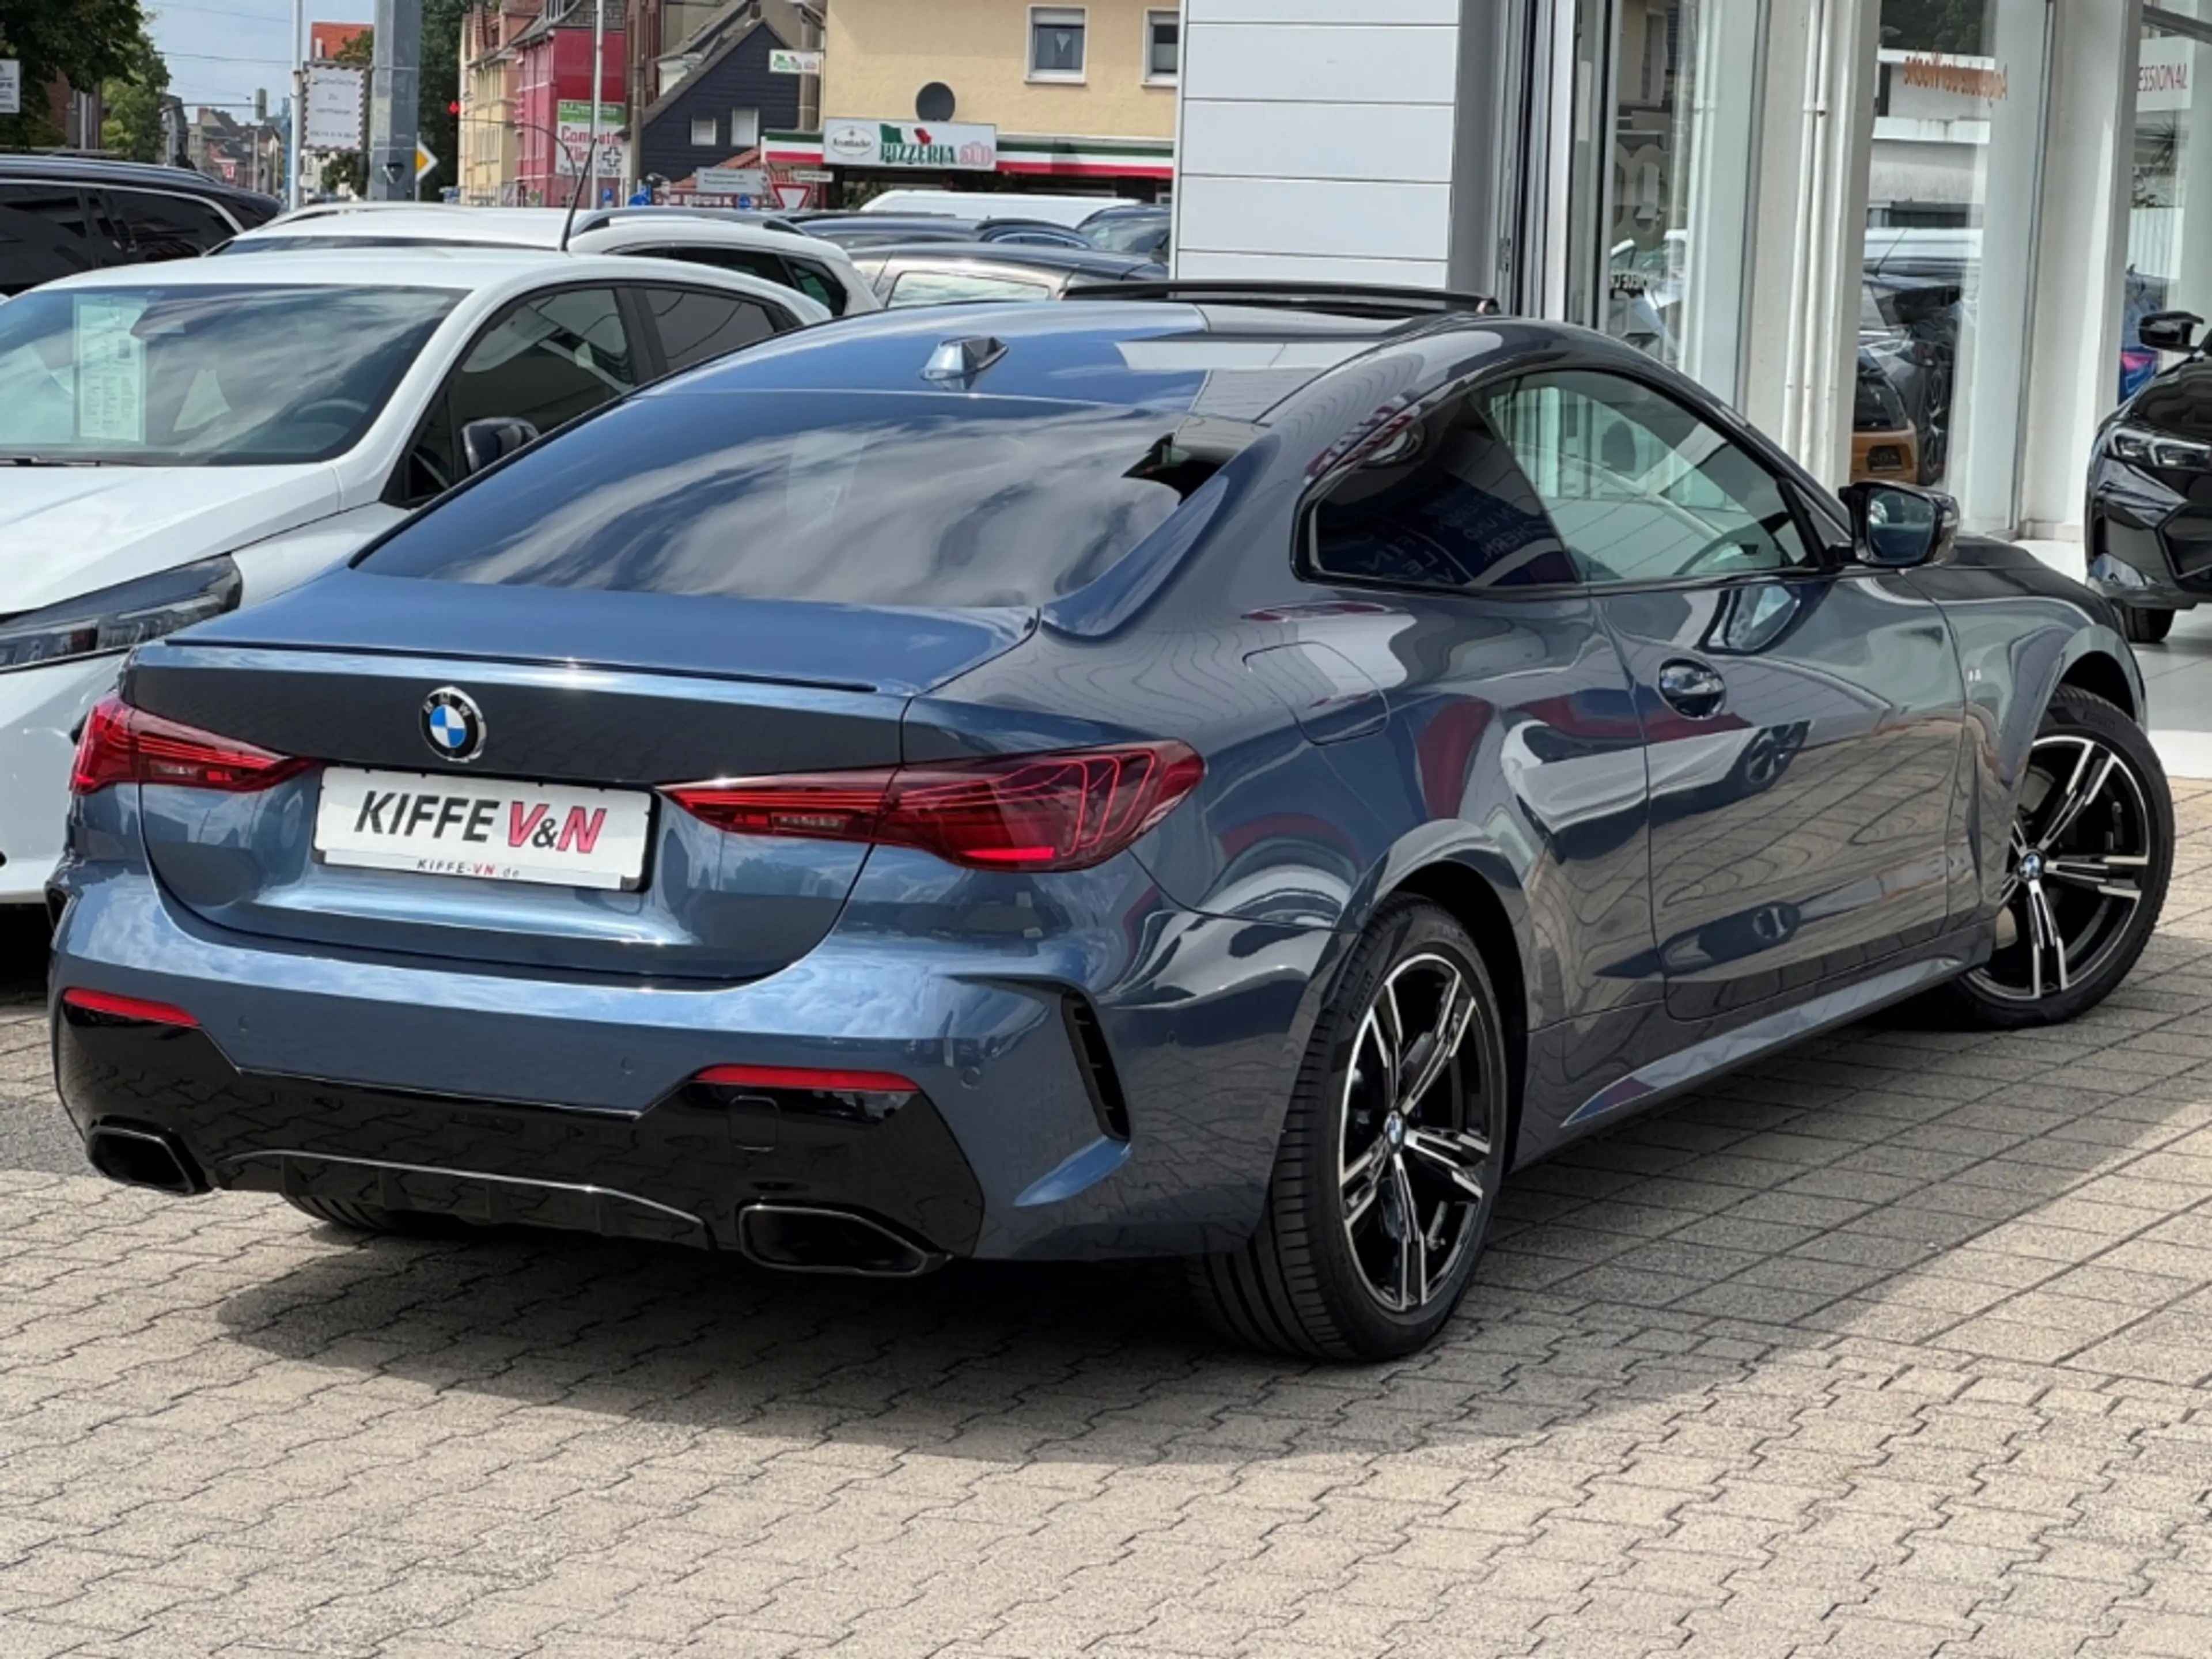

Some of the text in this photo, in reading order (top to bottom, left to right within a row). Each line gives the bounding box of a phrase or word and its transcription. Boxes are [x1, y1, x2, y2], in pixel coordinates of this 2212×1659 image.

[879, 142, 957, 165] PIZZERIA
[354, 790, 607, 854] KIFFE V&N
[416, 858, 521, 878] KIFFE-VN.de
